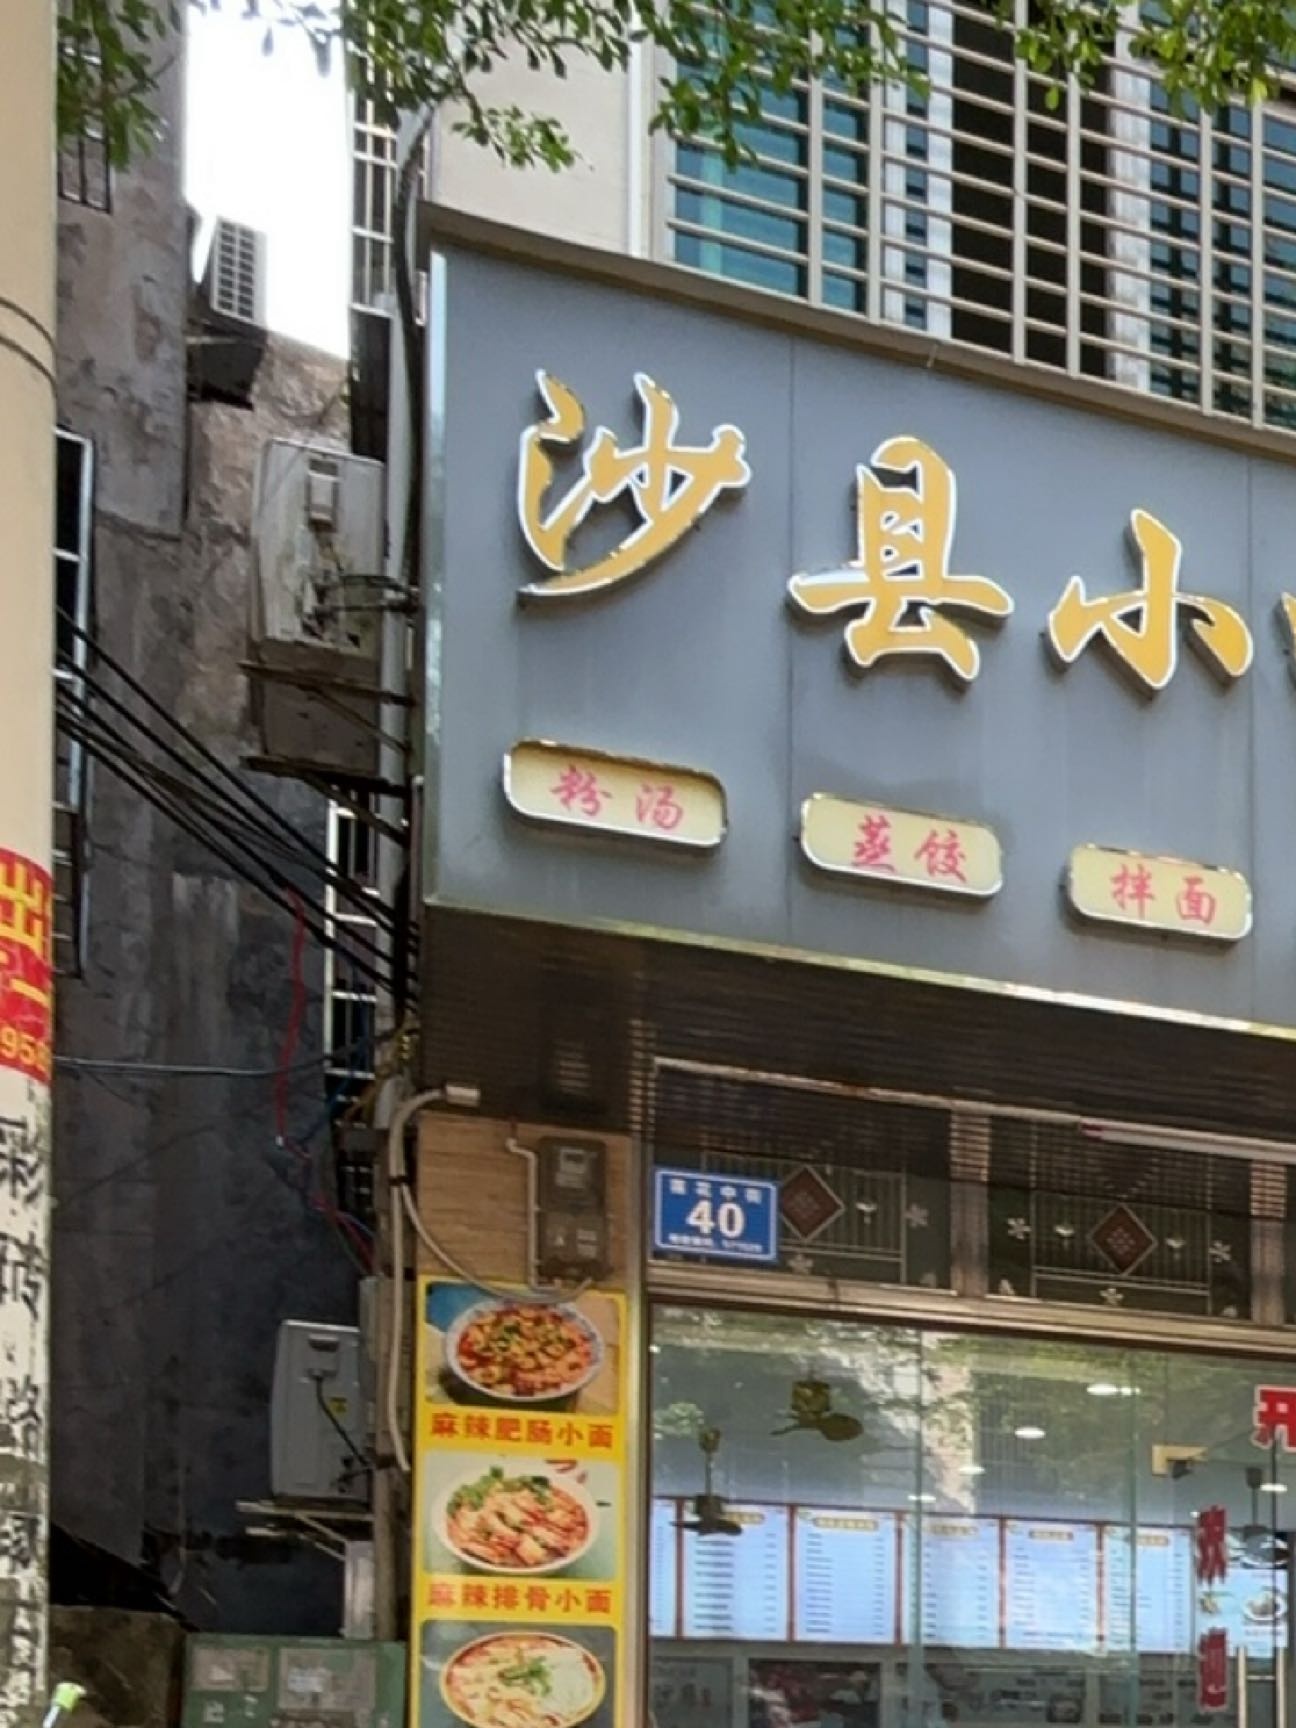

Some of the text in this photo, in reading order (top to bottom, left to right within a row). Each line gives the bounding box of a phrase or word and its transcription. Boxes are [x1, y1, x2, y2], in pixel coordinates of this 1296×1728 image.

[550, 763, 683, 830] 粉汤
[852, 813, 967, 884] 蒸饺
[1111, 864, 1216, 926] 拌面
[685, 1199, 745, 1239] 40
[430, 1411, 614, 1449] 麻辣肥肠小面
[429, 1583, 613, 1614] 麻辣排骨小面
